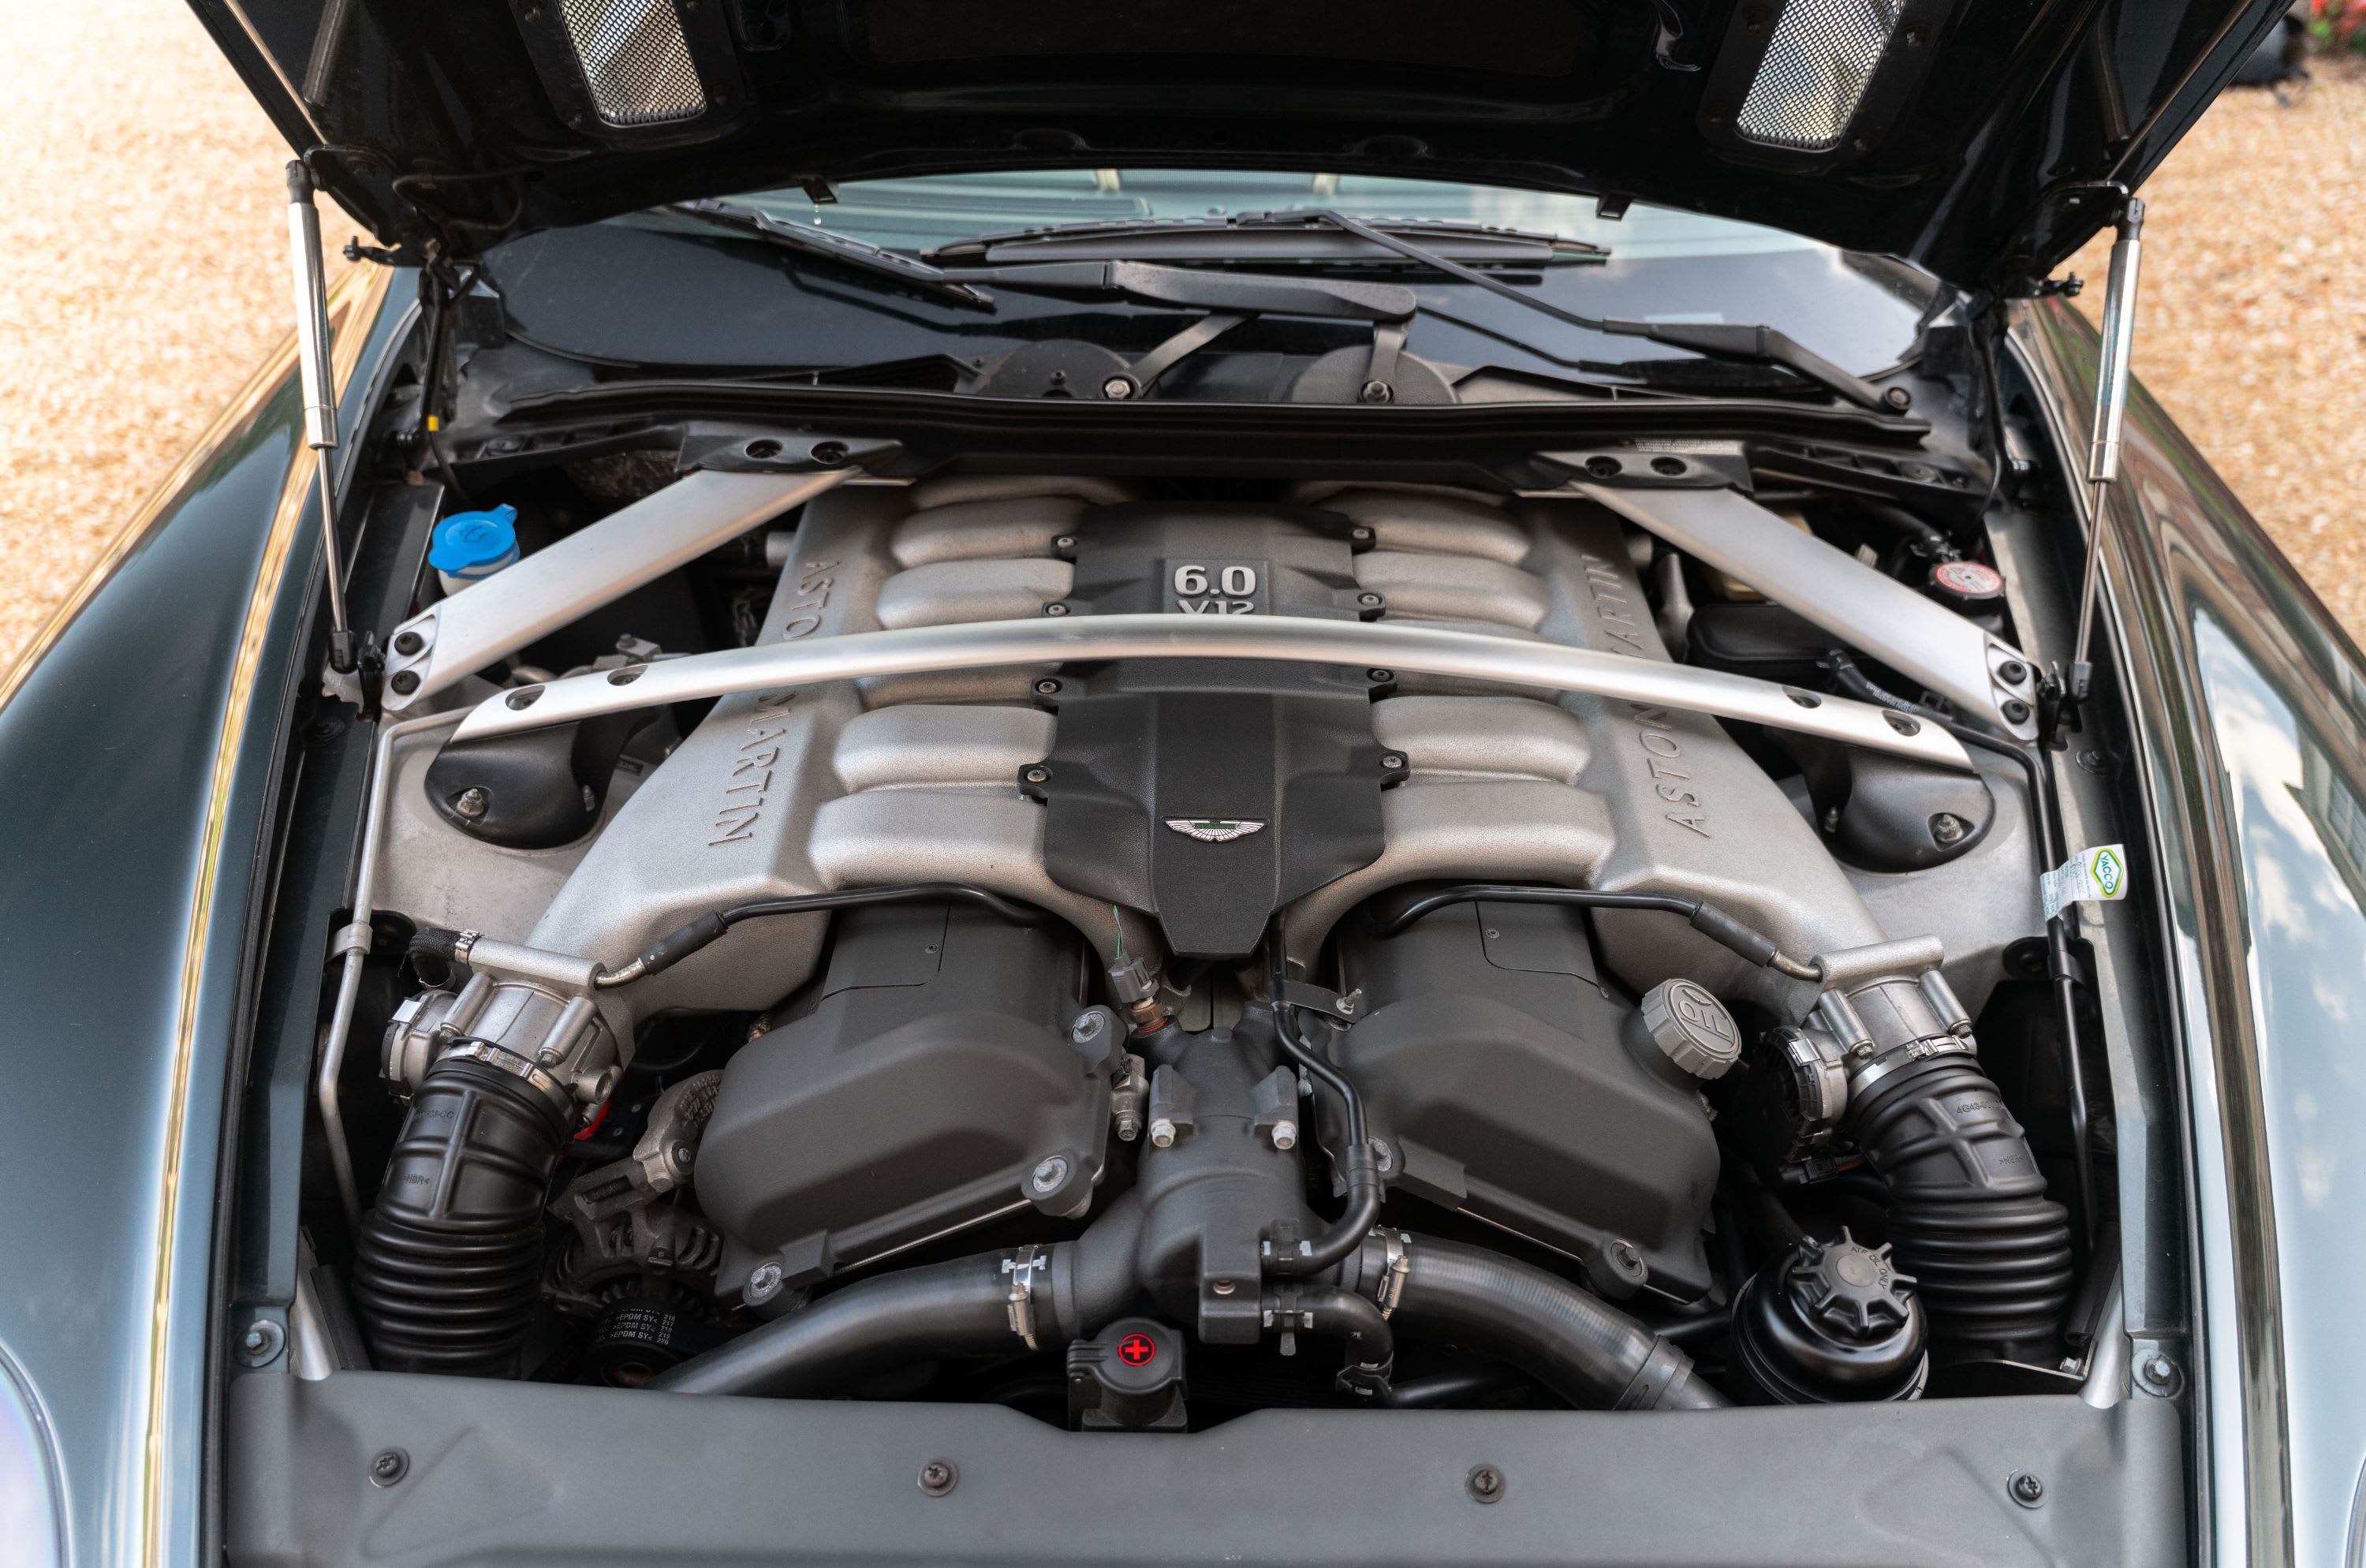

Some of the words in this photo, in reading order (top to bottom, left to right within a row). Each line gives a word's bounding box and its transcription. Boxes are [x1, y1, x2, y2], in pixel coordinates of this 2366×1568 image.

[1174, 565, 1256, 597] 6.0
[782, 561, 840, 640] ASTO
[1629, 700, 1711, 839] ASTON
[2100, 854, 2114, 890] YACCO
[1678, 1000, 1730, 1039] OIL
[1869, 1254, 1881, 1267] OIL
[1878, 1268, 1889, 1290] ONLY
